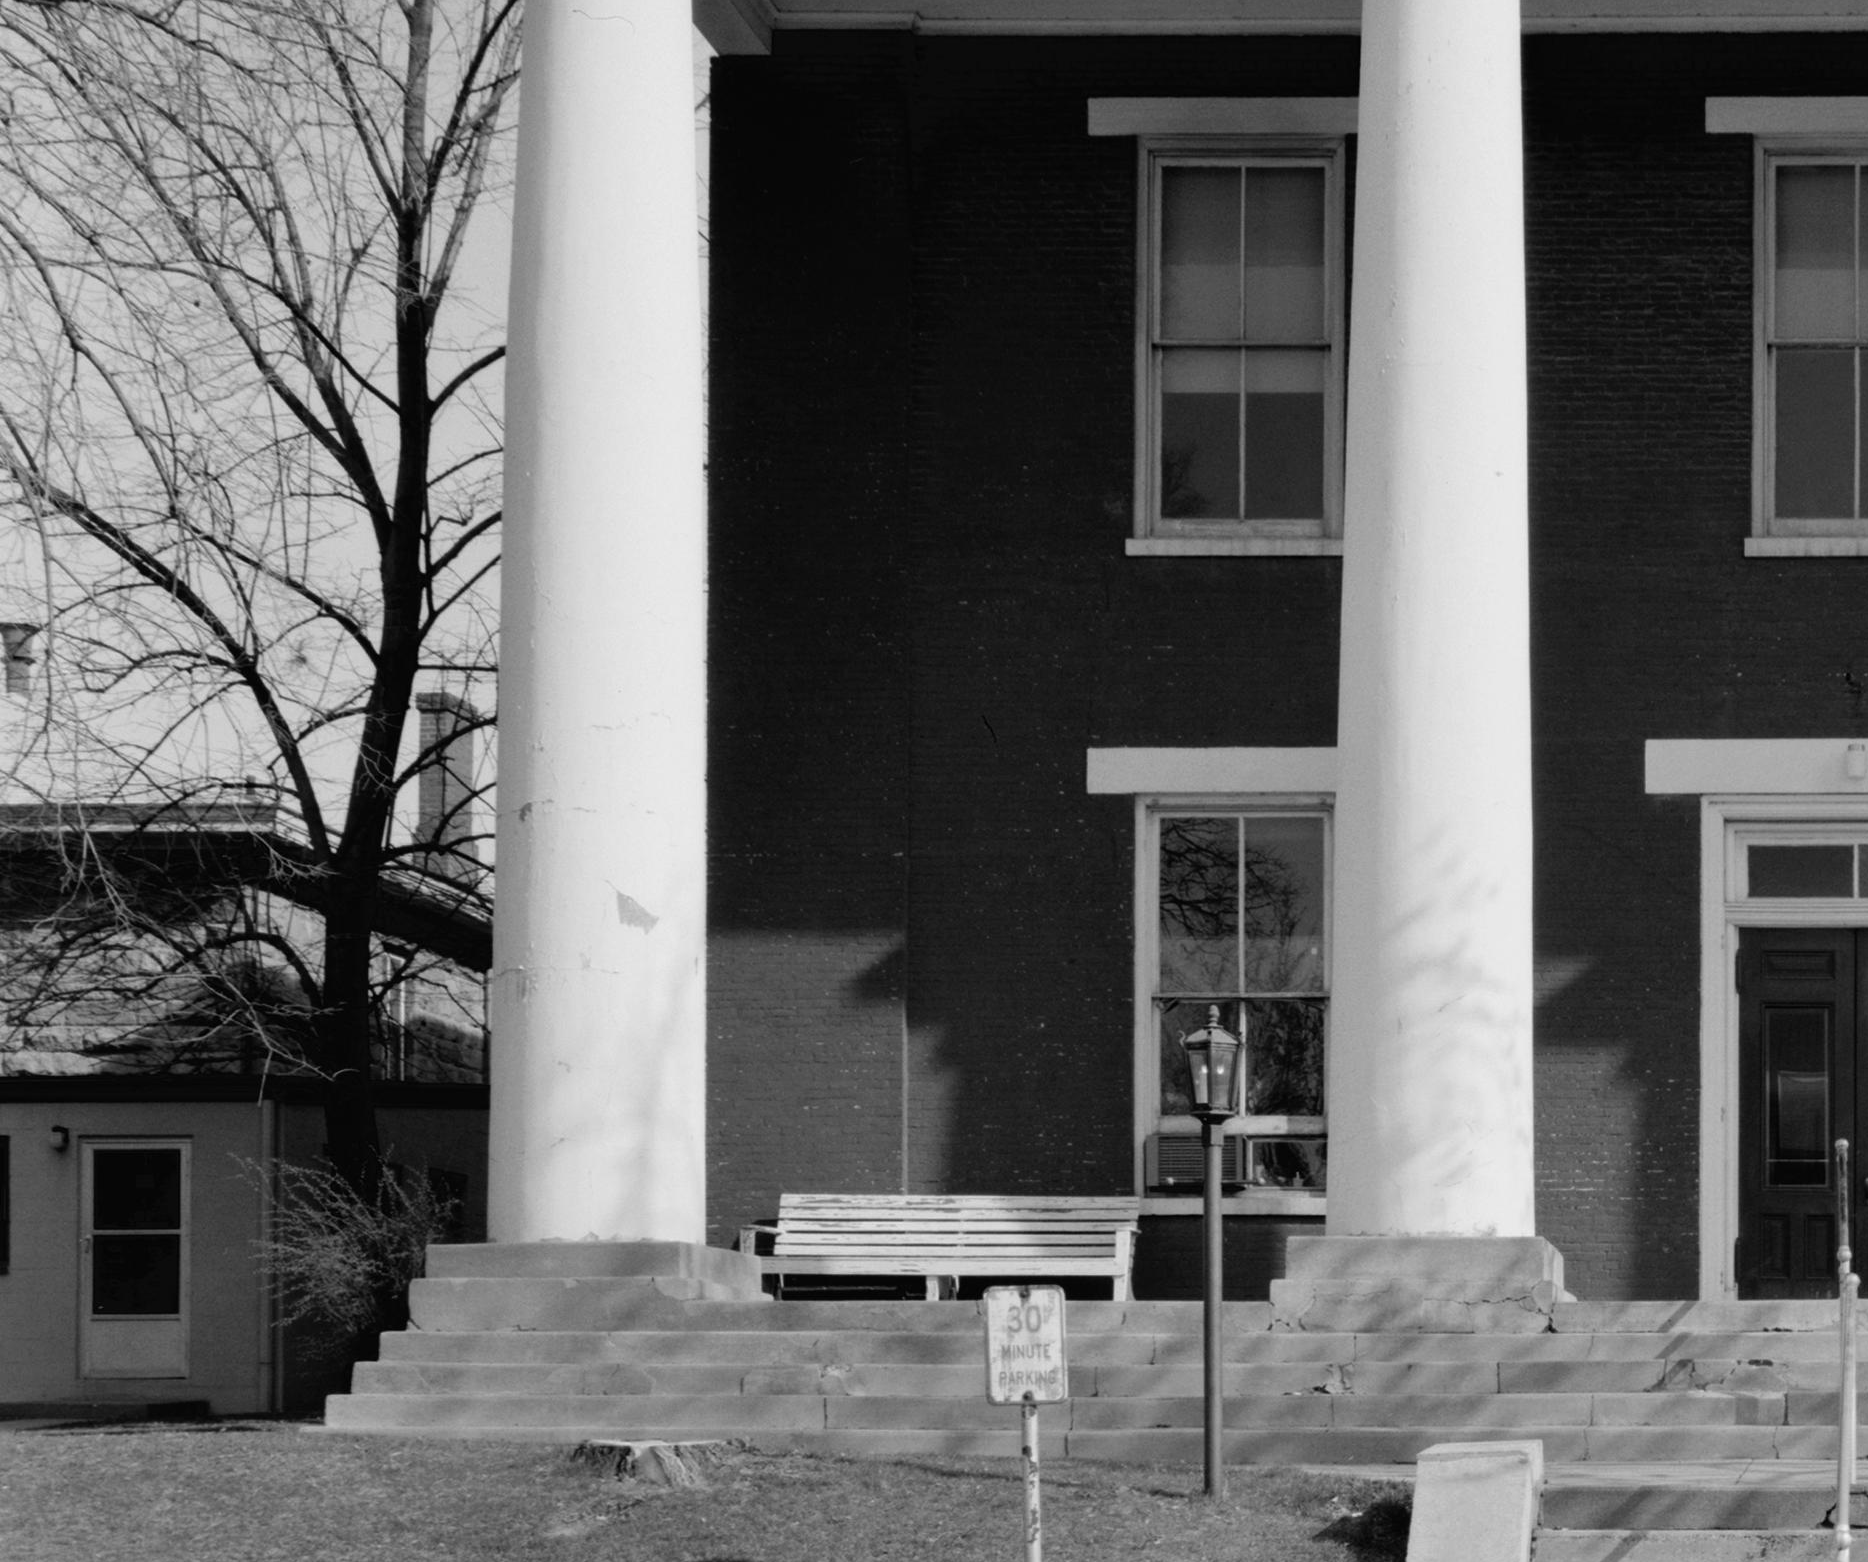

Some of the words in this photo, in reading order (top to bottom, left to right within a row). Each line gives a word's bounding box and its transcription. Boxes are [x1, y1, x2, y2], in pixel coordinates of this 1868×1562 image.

[1007, 1305, 1042, 1333] 30
[1001, 1344, 1052, 1360] MINUTE
[999, 1370, 1056, 1386] PARKING
